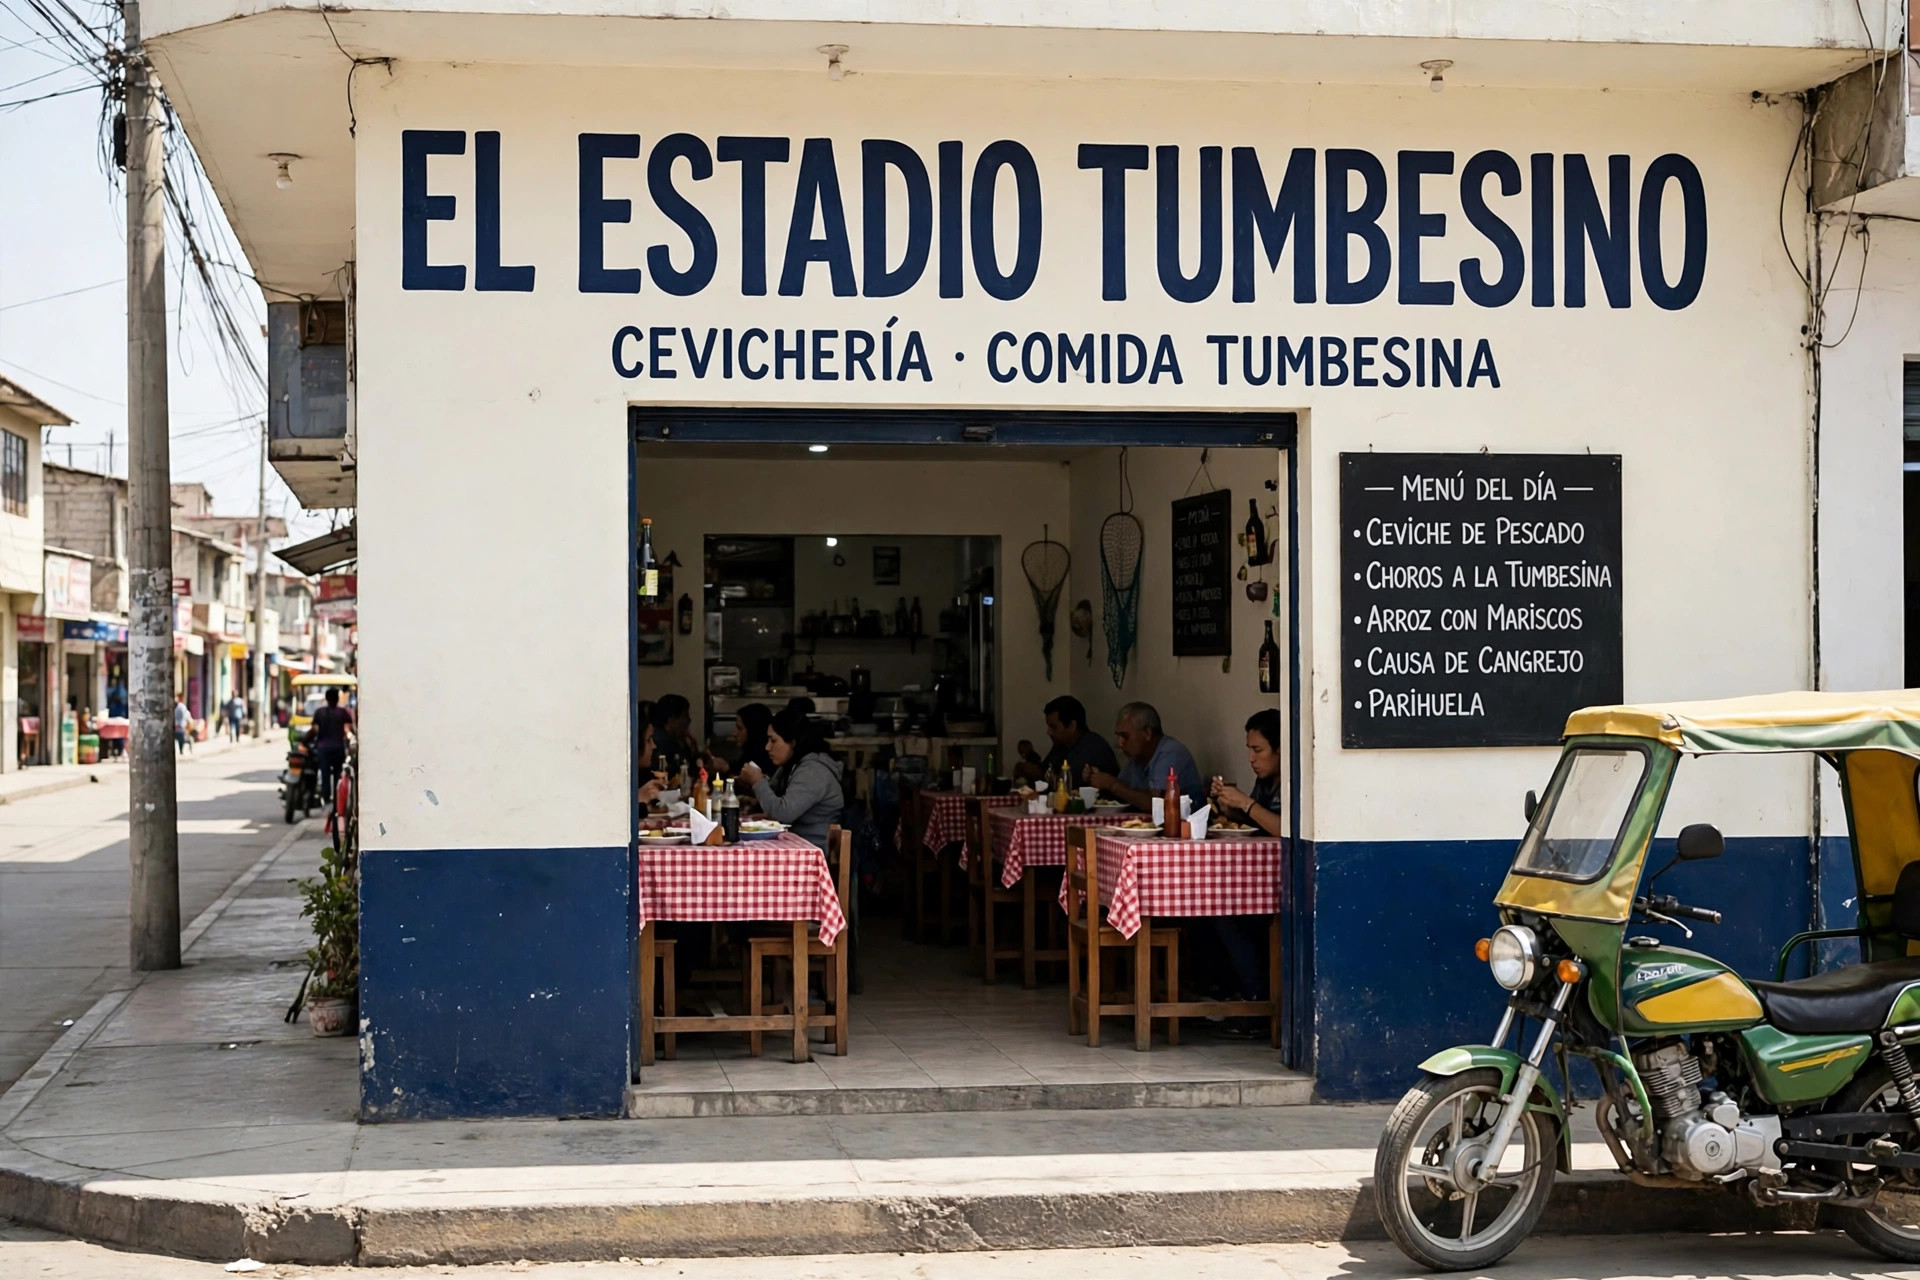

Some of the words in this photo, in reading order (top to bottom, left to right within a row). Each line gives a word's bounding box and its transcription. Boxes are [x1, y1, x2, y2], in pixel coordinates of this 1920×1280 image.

[402, 130, 535, 293] EL
[578, 132, 1042, 302] ESTADIO
[1078, 143, 1707, 311] TUMBESINO
[612, 316, 933, 383] CEVICHERÍA
[988, 331, 1184, 386] COMIDA
[1207, 334, 1501, 389] TUMBESINA
[1402, 470, 1465, 502] MENÚ
[1476, 477, 1514, 502] DEL
[1523, 470, 1558, 502] DÍA
[1366, 517, 1452, 546] CEVICHE
[1462, 522, 1486, 545] DE
[1496, 516, 1585, 546] PESCADO
[1366, 560, 1443, 590] CHOROS
[1452, 566, 1466, 588] A
[1475, 566, 1499, 588] LA
[1505, 559, 1612, 589] TUMBESINA
[1366, 604, 1432, 633] ARROZ
[1440, 608, 1477, 632] CON
[1487, 603, 1583, 632] MARISCOS
[1367, 646, 1436, 676] CAUSA
[1444, 651, 1469, 674] DE
[1478, 645, 1584, 674] CANGREJO
[1368, 688, 1485, 718] PARIHUELA
